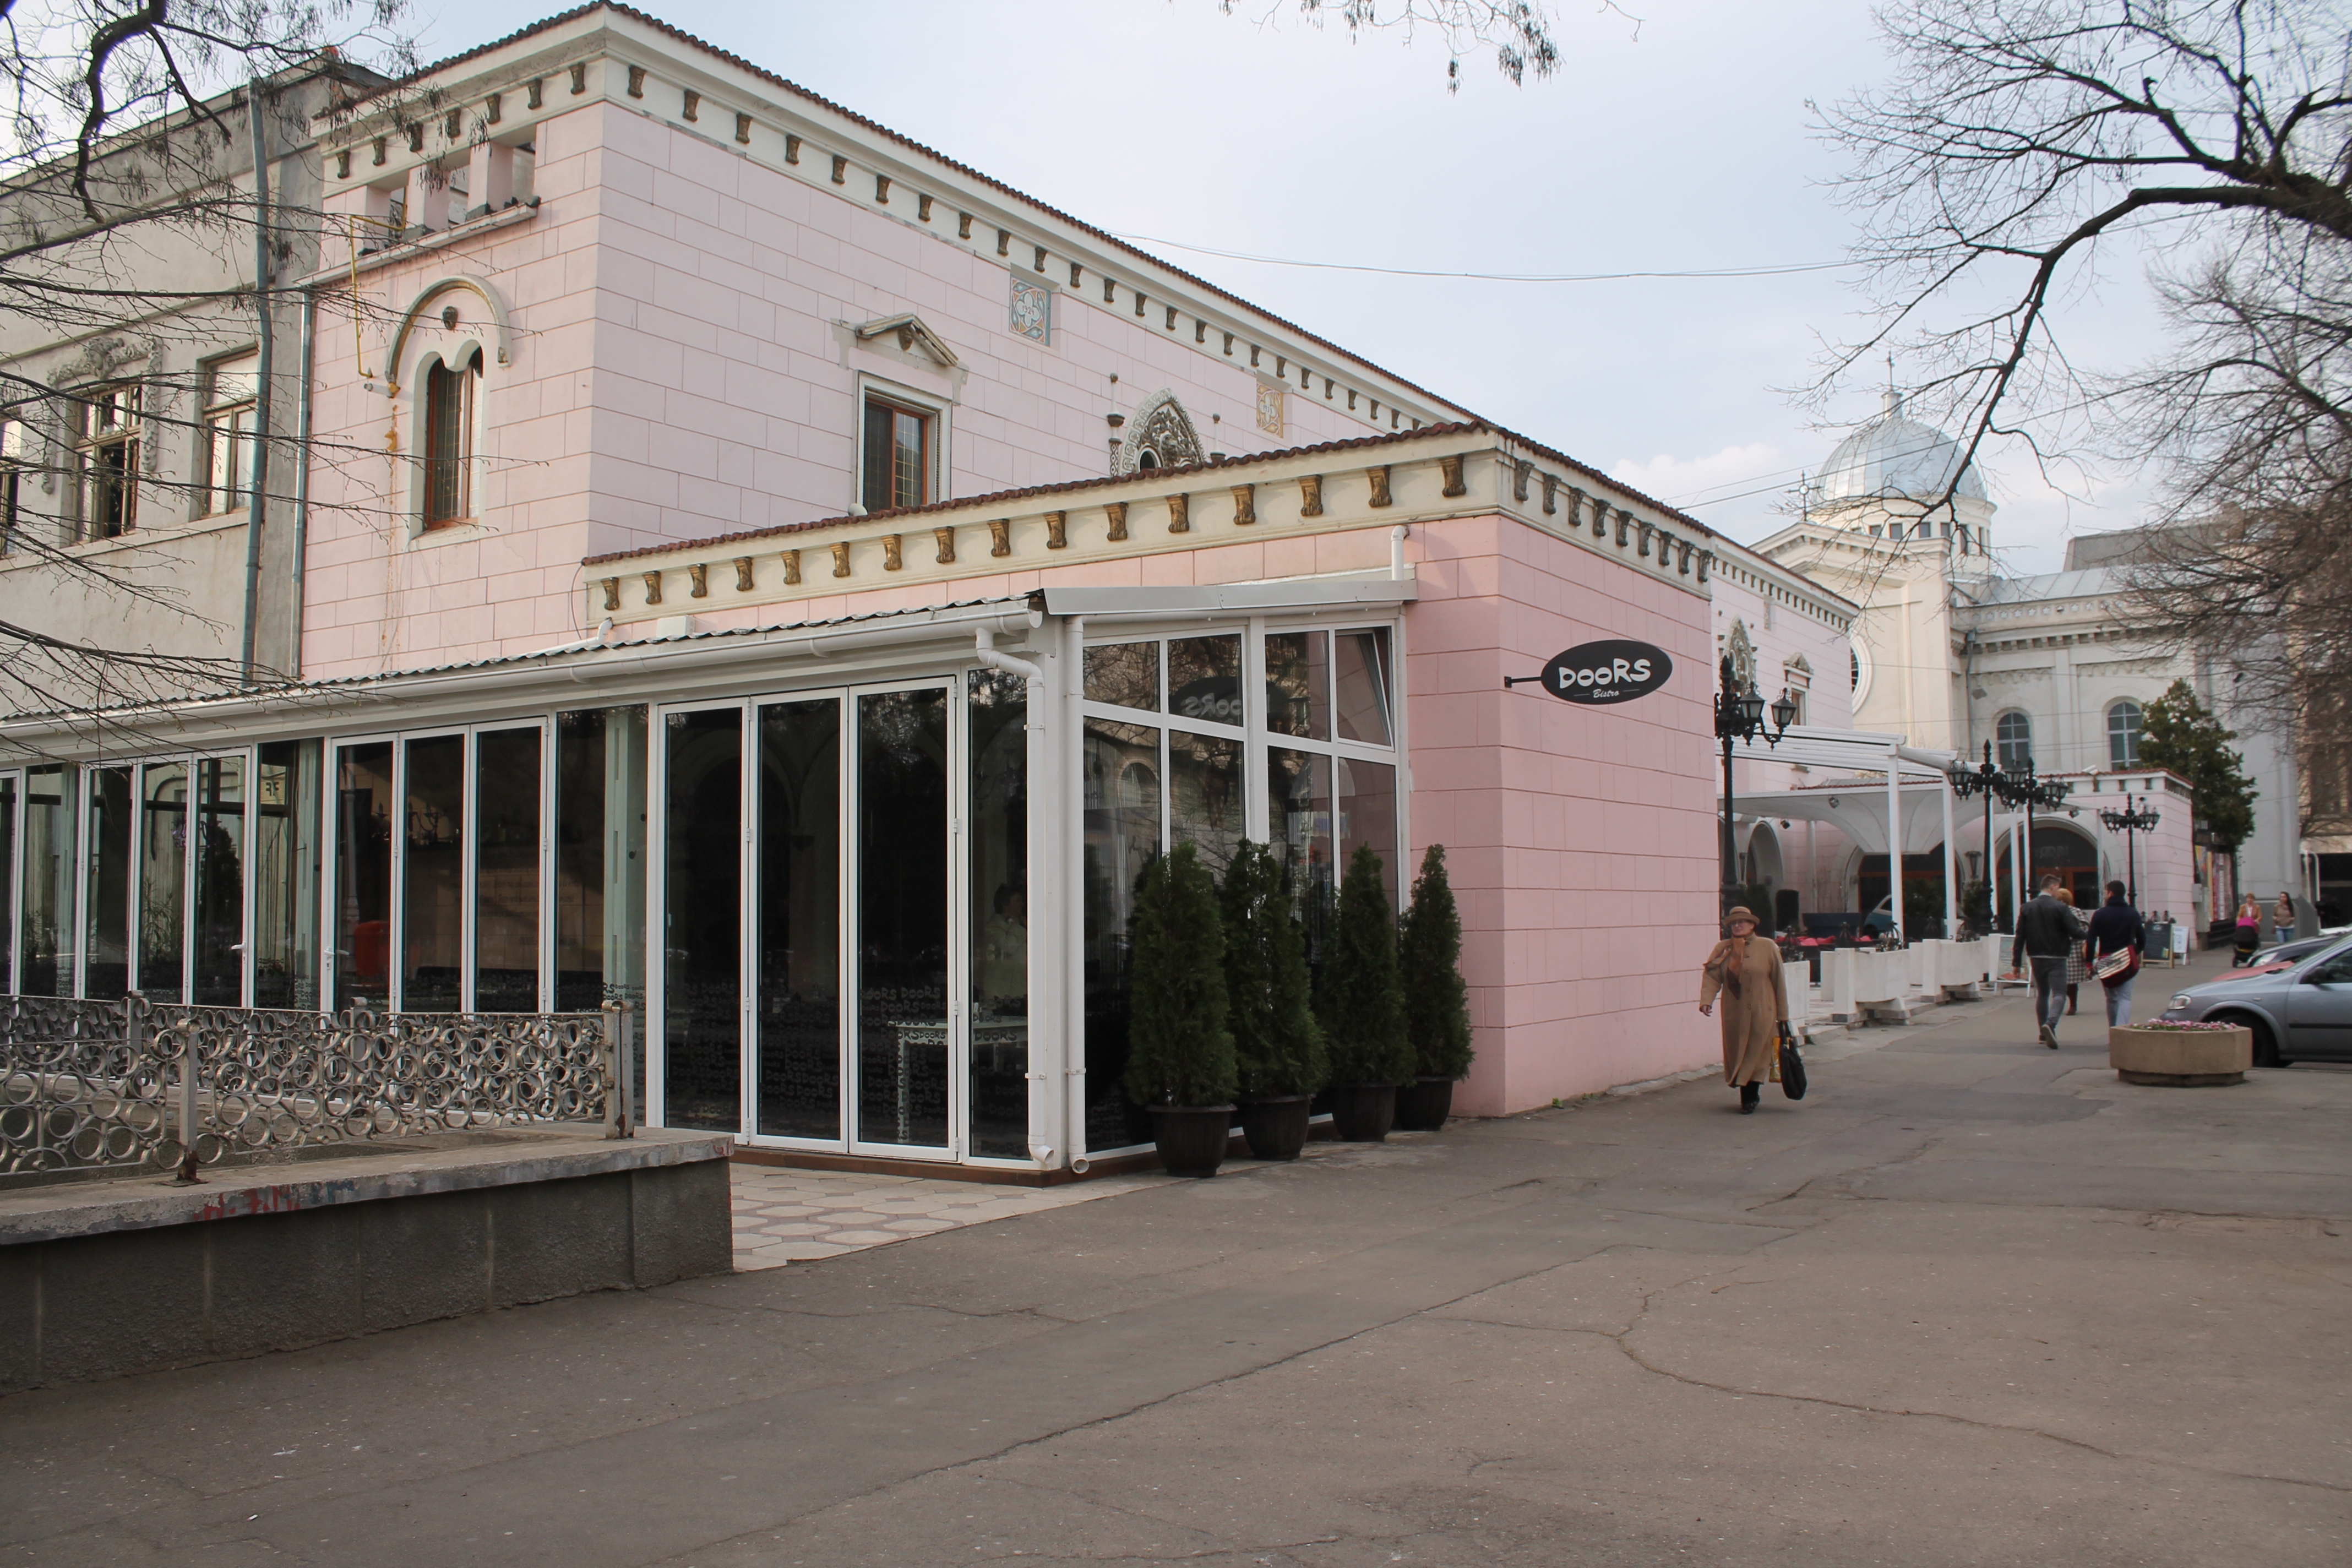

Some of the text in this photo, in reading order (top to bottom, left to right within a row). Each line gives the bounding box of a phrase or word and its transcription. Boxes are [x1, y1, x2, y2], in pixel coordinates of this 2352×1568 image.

[1559, 658, 1651, 689] DOORS
[1593, 689, 1620, 698] Bistro
[901, 986, 940, 999] DOORS
[881, 1000, 920, 1013] DOORS
[920, 1031, 946, 1039] DOORS
[975, 1029, 1017, 1042] DOORS
[785, 1048, 821, 1060] DOORS
[785, 1058, 823, 1072] DOORS
[766, 1069, 839, 1086] DOORS DOORS
[796, 1084, 833, 1098] DOORS
